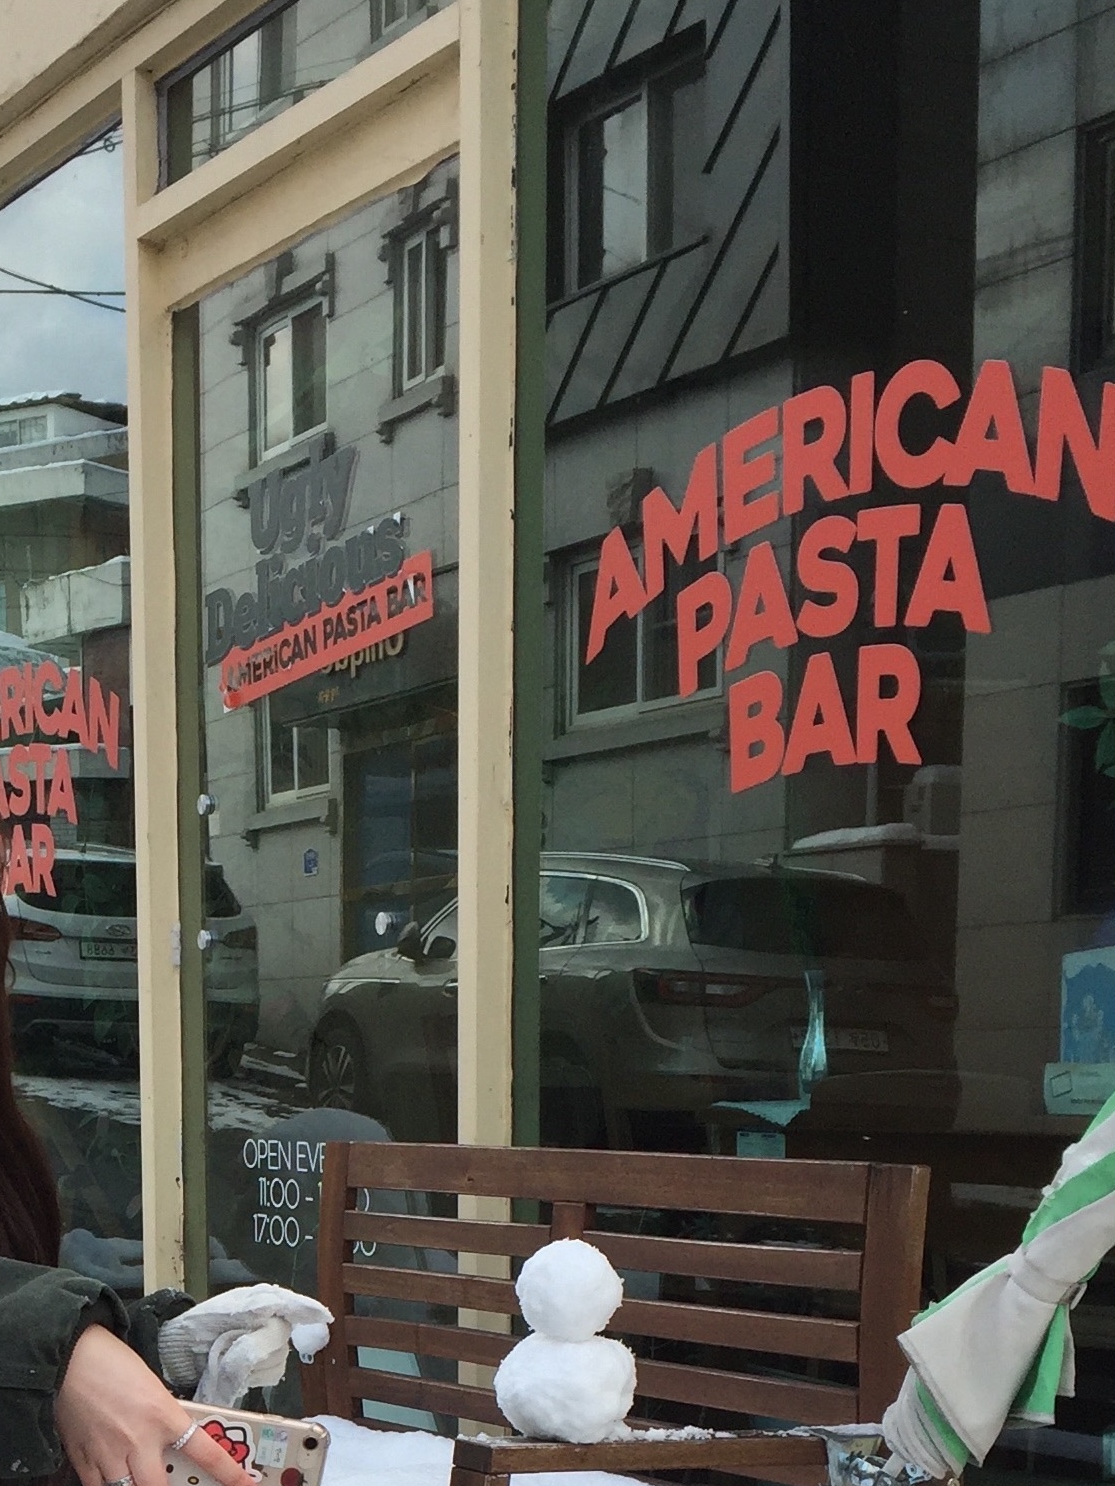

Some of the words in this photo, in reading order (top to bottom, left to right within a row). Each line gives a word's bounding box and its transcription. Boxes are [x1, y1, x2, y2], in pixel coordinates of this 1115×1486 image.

[248, 441, 360, 556] Ugly
[585, 358, 1115, 665] AMERICAN
[322, 593, 382, 651] PASTA
[386, 571, 428, 621] BAR
[676, 503, 993, 699] PASTA
[730, 642, 924, 795] BAR
[0, 822, 58, 898] AR
[242, 1138, 292, 1171] OPEN
[258, 1176, 300, 1210] 11:00
[252, 1213, 300, 1248] 17:00
